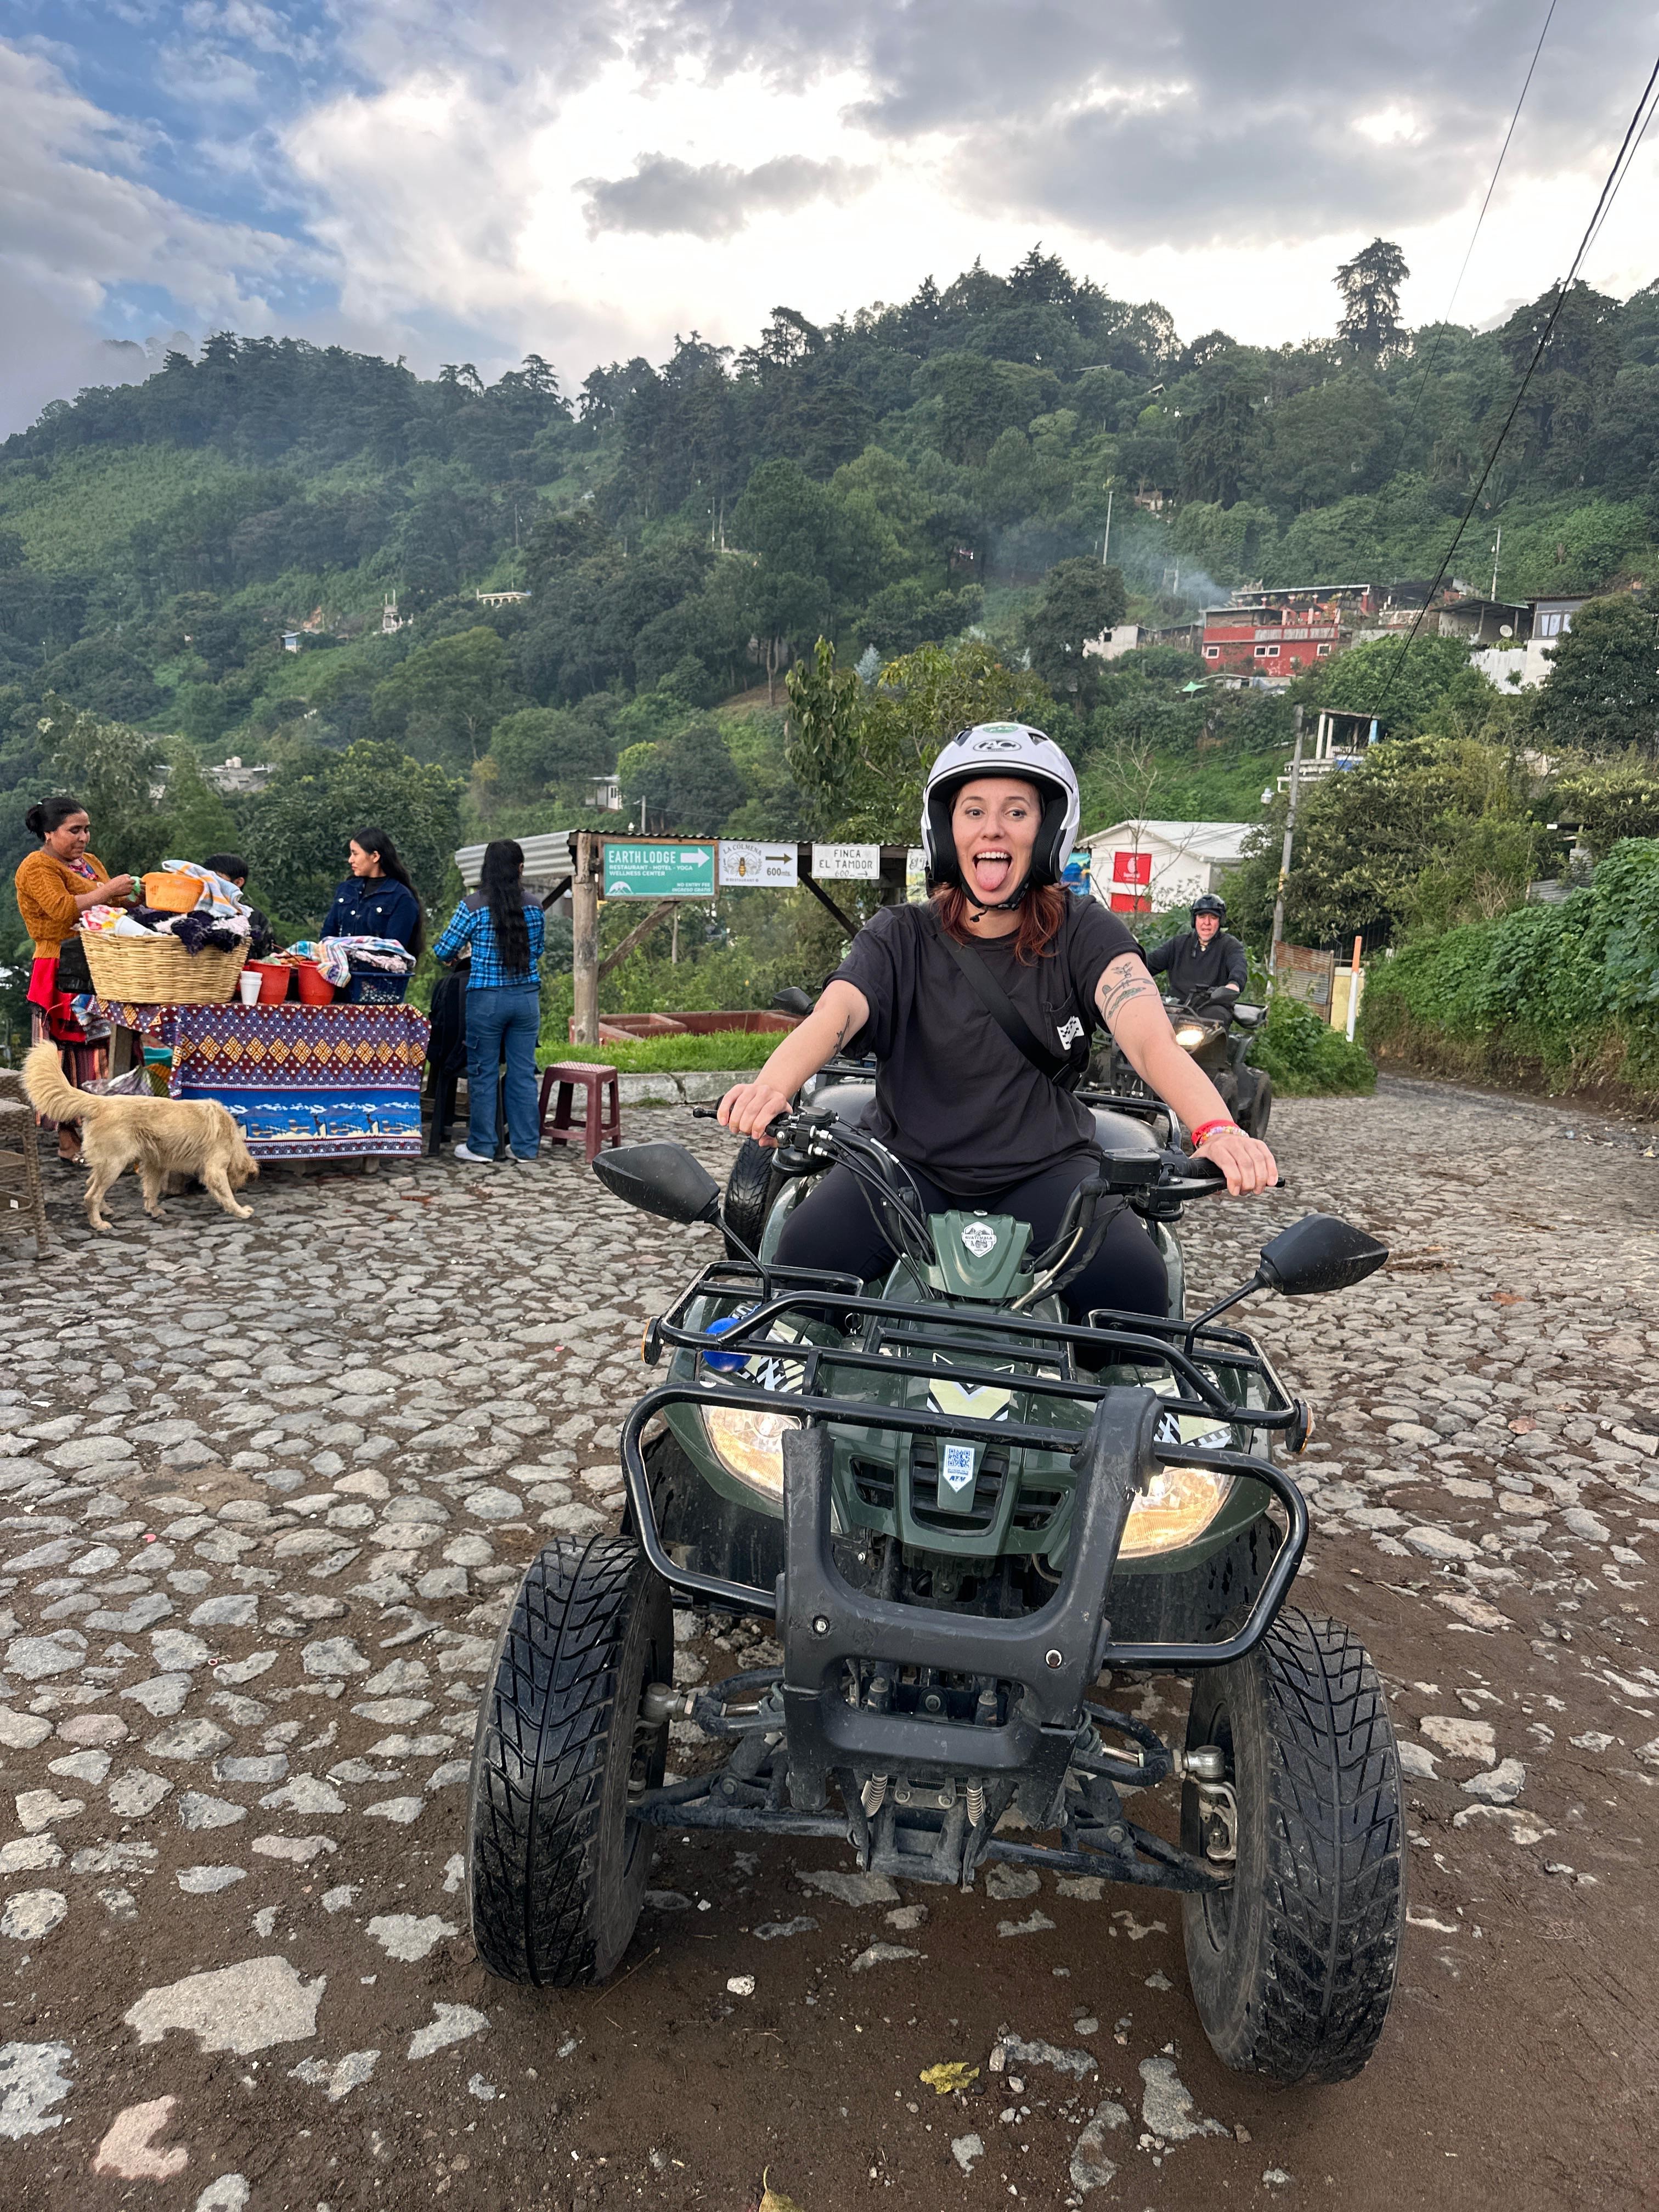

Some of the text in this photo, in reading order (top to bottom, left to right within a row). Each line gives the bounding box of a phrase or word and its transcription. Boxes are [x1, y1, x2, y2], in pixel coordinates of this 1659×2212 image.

[608, 850, 676, 864] EARTH LODGE
[834, 849, 861, 858] FINCA
[819, 860, 872, 870] EL TAMBOR
[767, 867, 781, 876] 600
